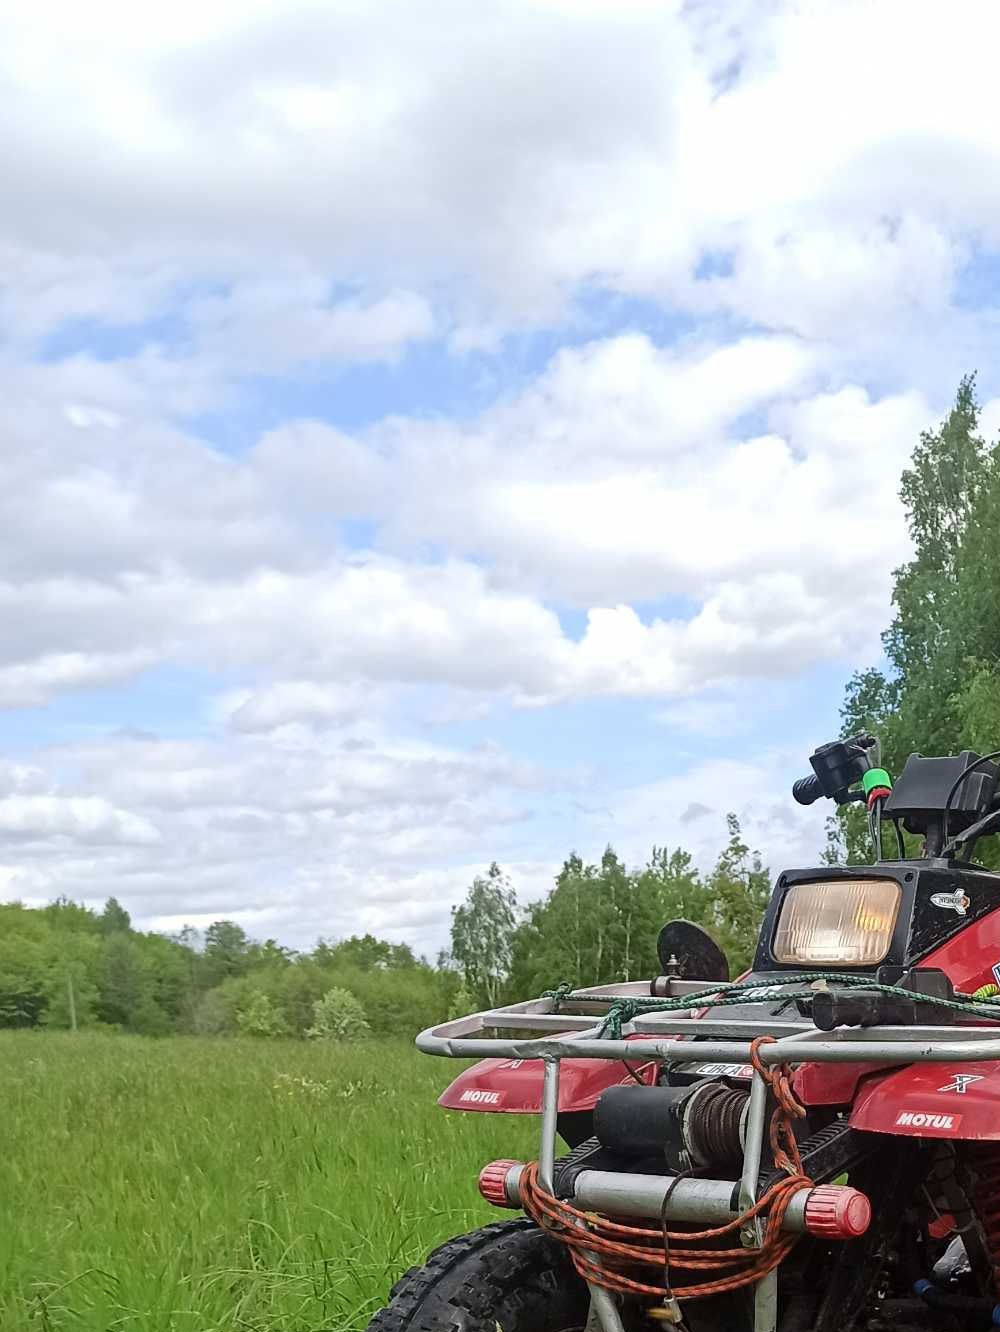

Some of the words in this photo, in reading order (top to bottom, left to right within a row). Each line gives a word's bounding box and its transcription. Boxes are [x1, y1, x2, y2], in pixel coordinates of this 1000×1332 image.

[698, 1063, 741, 1074] CIRCA
[460, 1090, 500, 1103] MOTUL
[896, 1112, 954, 1129] MOTUL
